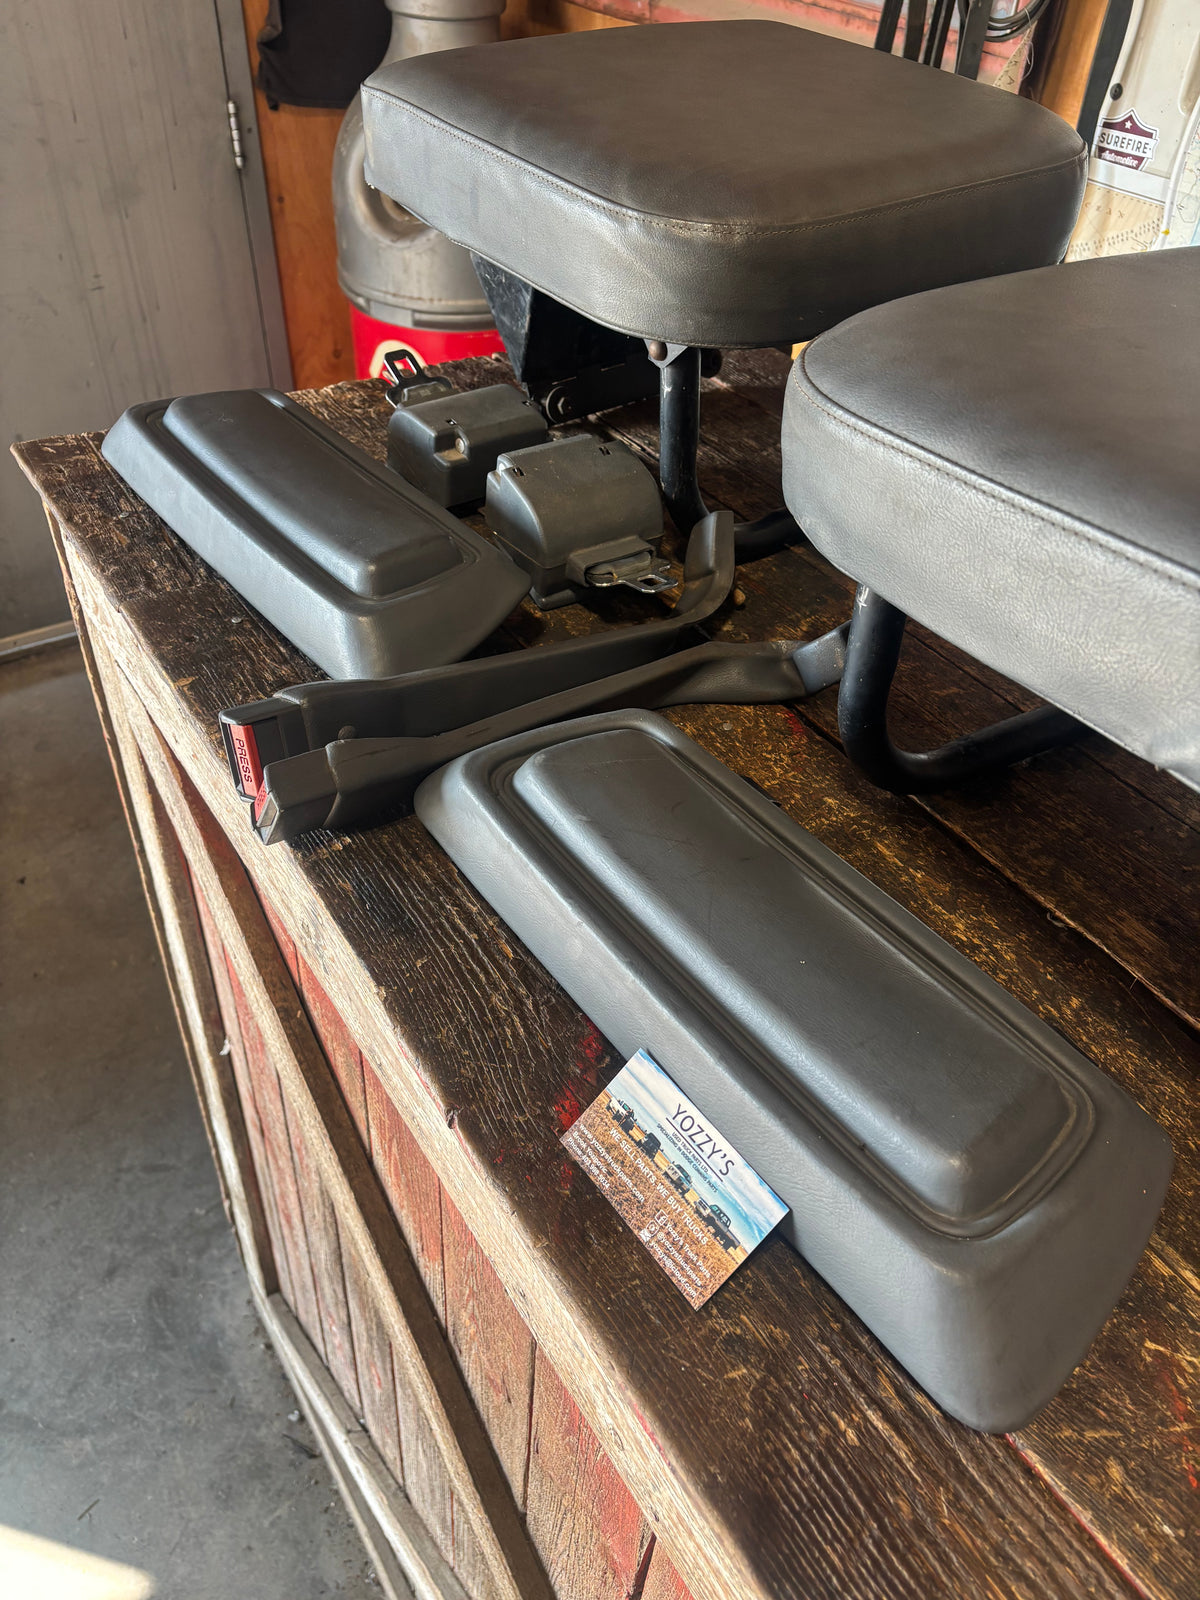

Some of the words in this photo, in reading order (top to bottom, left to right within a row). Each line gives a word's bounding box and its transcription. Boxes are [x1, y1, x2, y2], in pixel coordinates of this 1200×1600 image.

[1099, 132, 1150, 154] SUREFIRE
[236, 738, 252, 782] PRESS
[572, 1130, 587, 1149] Brook
[578, 1122, 645, 1204] www.yozzystruckparts.com
[656, 1123, 678, 1148] SPECIALIZING
[680, 1150, 693, 1165] DODGE
[691, 1163, 708, 1182] CUMMINS
[706, 1179, 718, 1193] PARTS
[669, 1103, 735, 1176] YOZZY'S
[671, 1131, 681, 1143] USED
[679, 1141, 692, 1155] TRUCK
[690, 1153, 702, 1166] PARTS
[608, 1127, 622, 1142] WE
[618, 1139, 637, 1160] SELL
[633, 1157, 658, 1186] PARTS,
[655, 1182, 669, 1198] WE
[666, 1195, 683, 1214] BUY
[679, 1211, 709, 1245] TRUCKS
[649, 1239, 698, 1298] yozzys@icloud.com
[655, 1230, 703, 1288] @yozzystruckparts
[664, 1222, 685, 1247] Yozzy's
[682, 1243, 698, 1262] Truck
[695, 1259, 712, 1278] Parts
